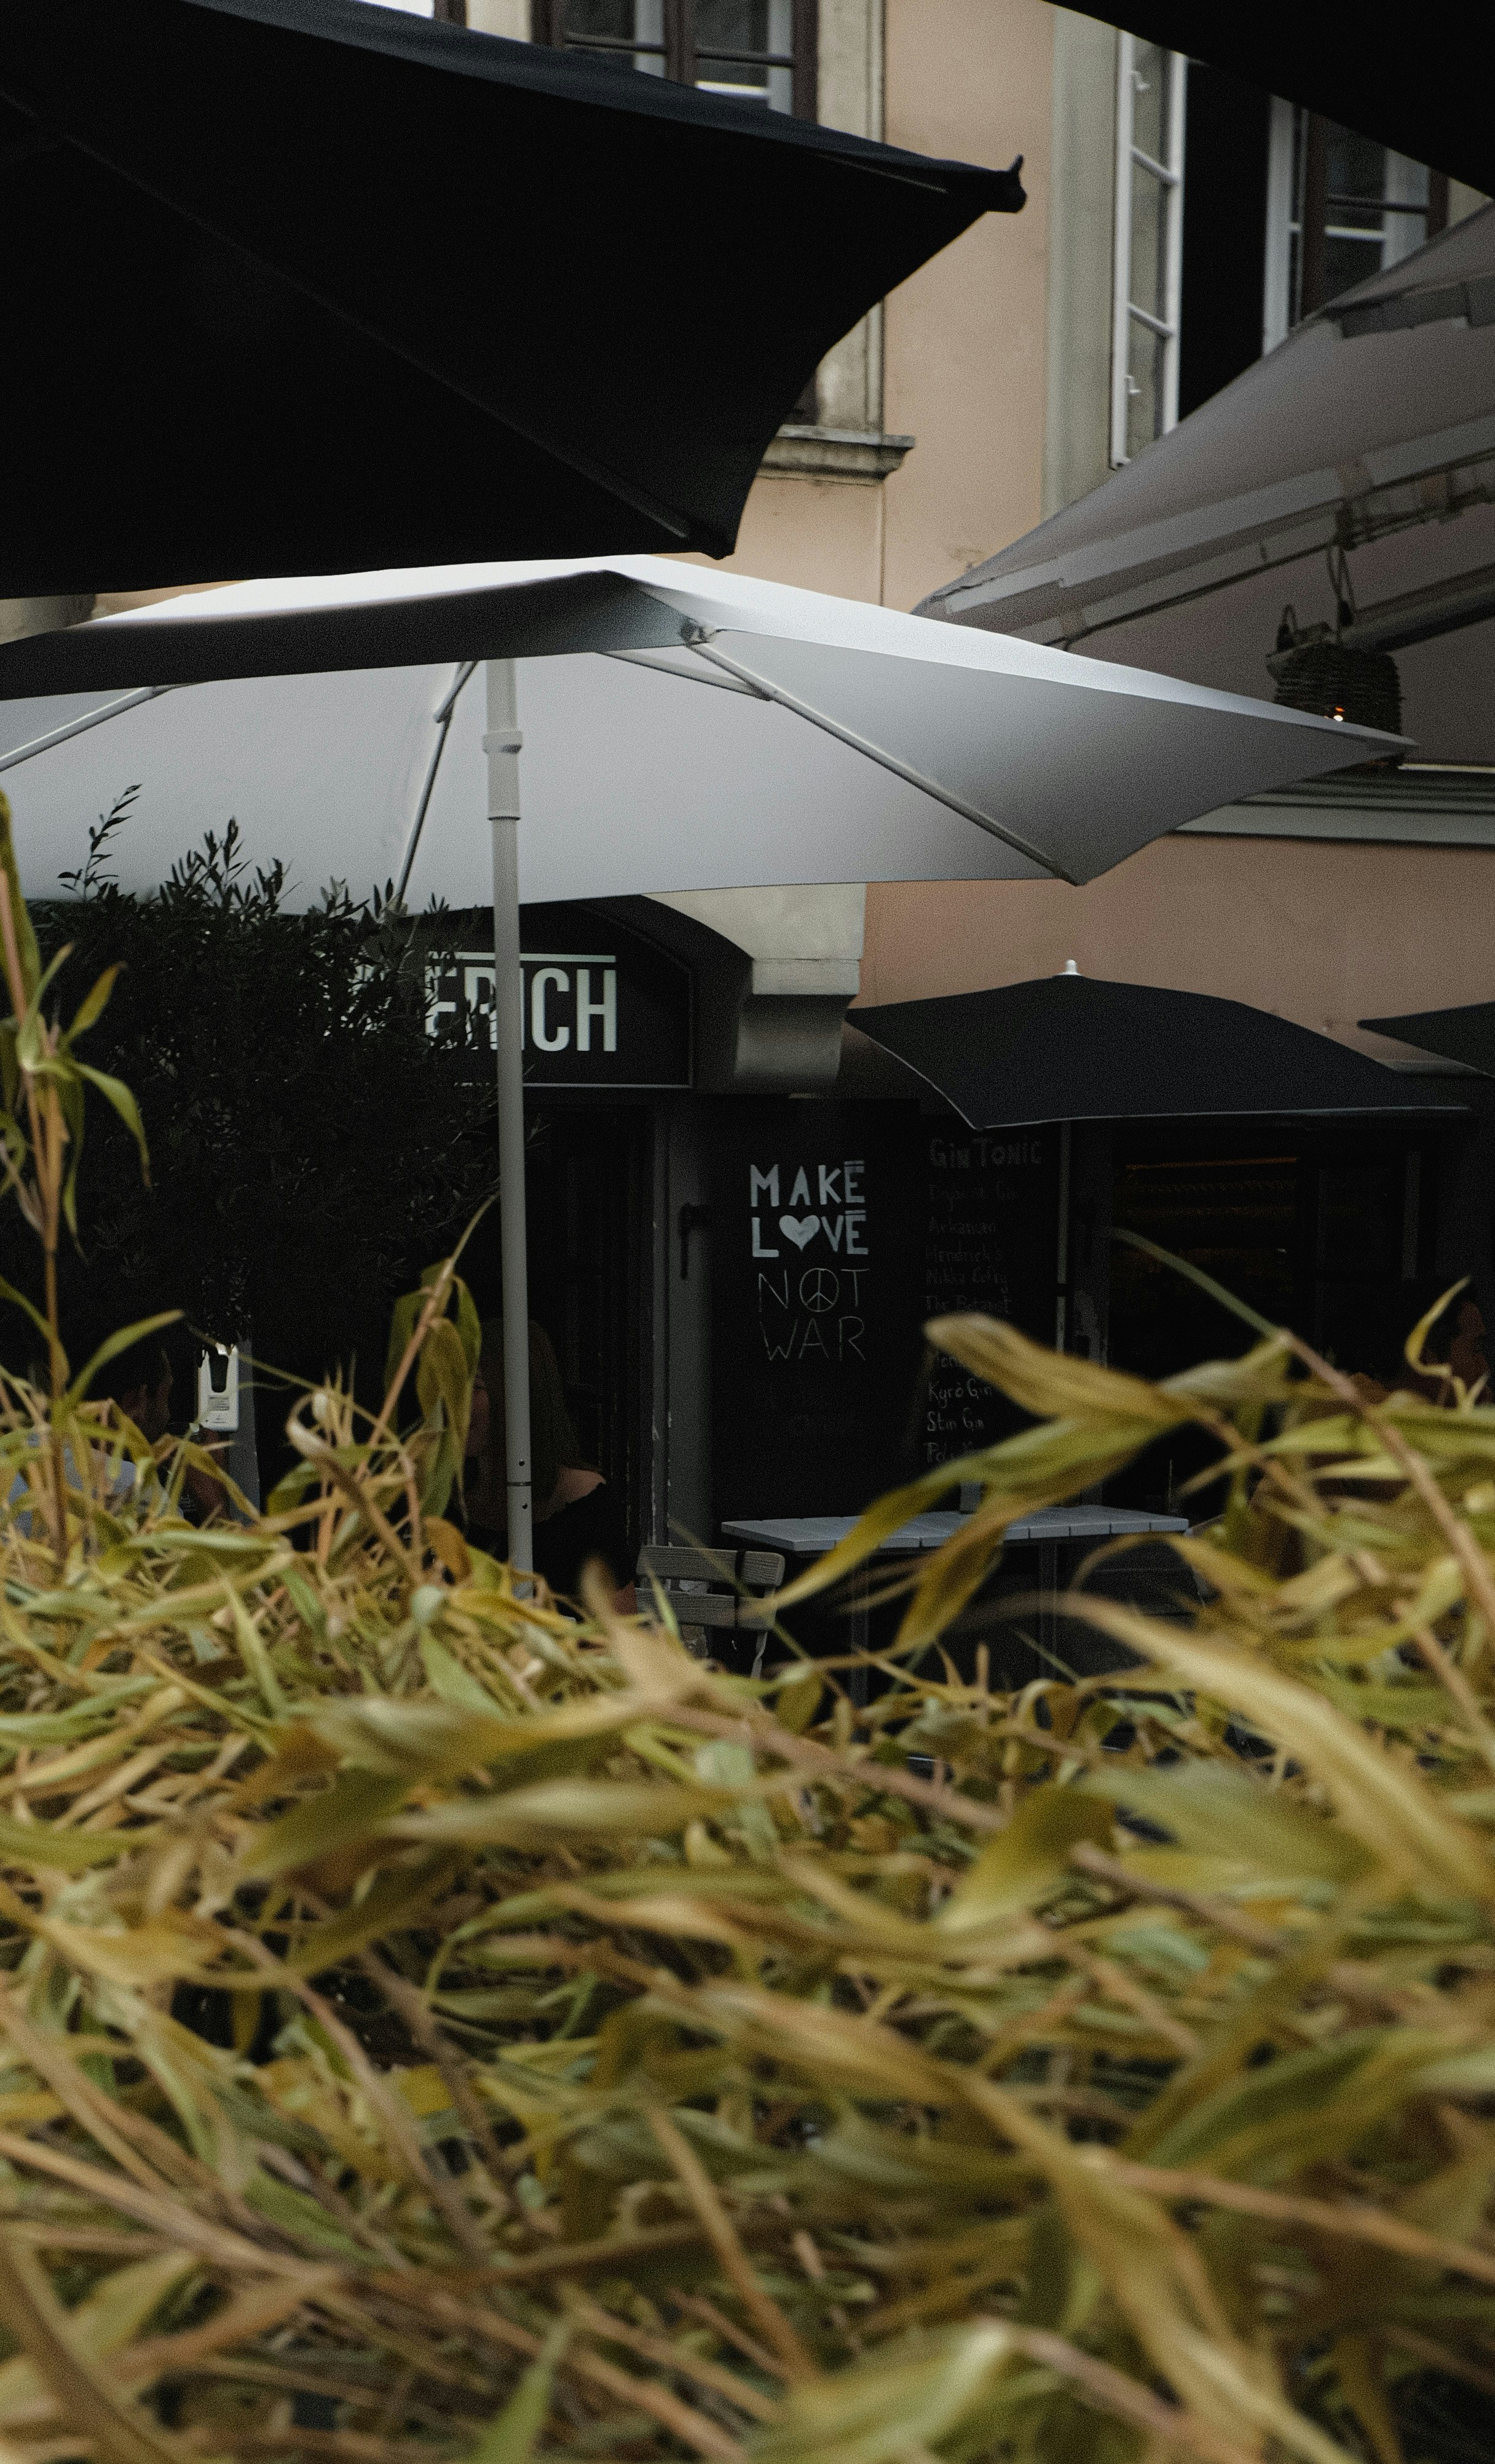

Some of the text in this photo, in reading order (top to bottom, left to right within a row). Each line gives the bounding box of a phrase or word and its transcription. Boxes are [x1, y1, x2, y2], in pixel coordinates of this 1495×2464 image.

[425, 964, 617, 1052] ERCH
[749, 1160, 866, 1208] MAKE
[759, 1315, 866, 1362] WAR
[967, 1377, 993, 1400] Gin
